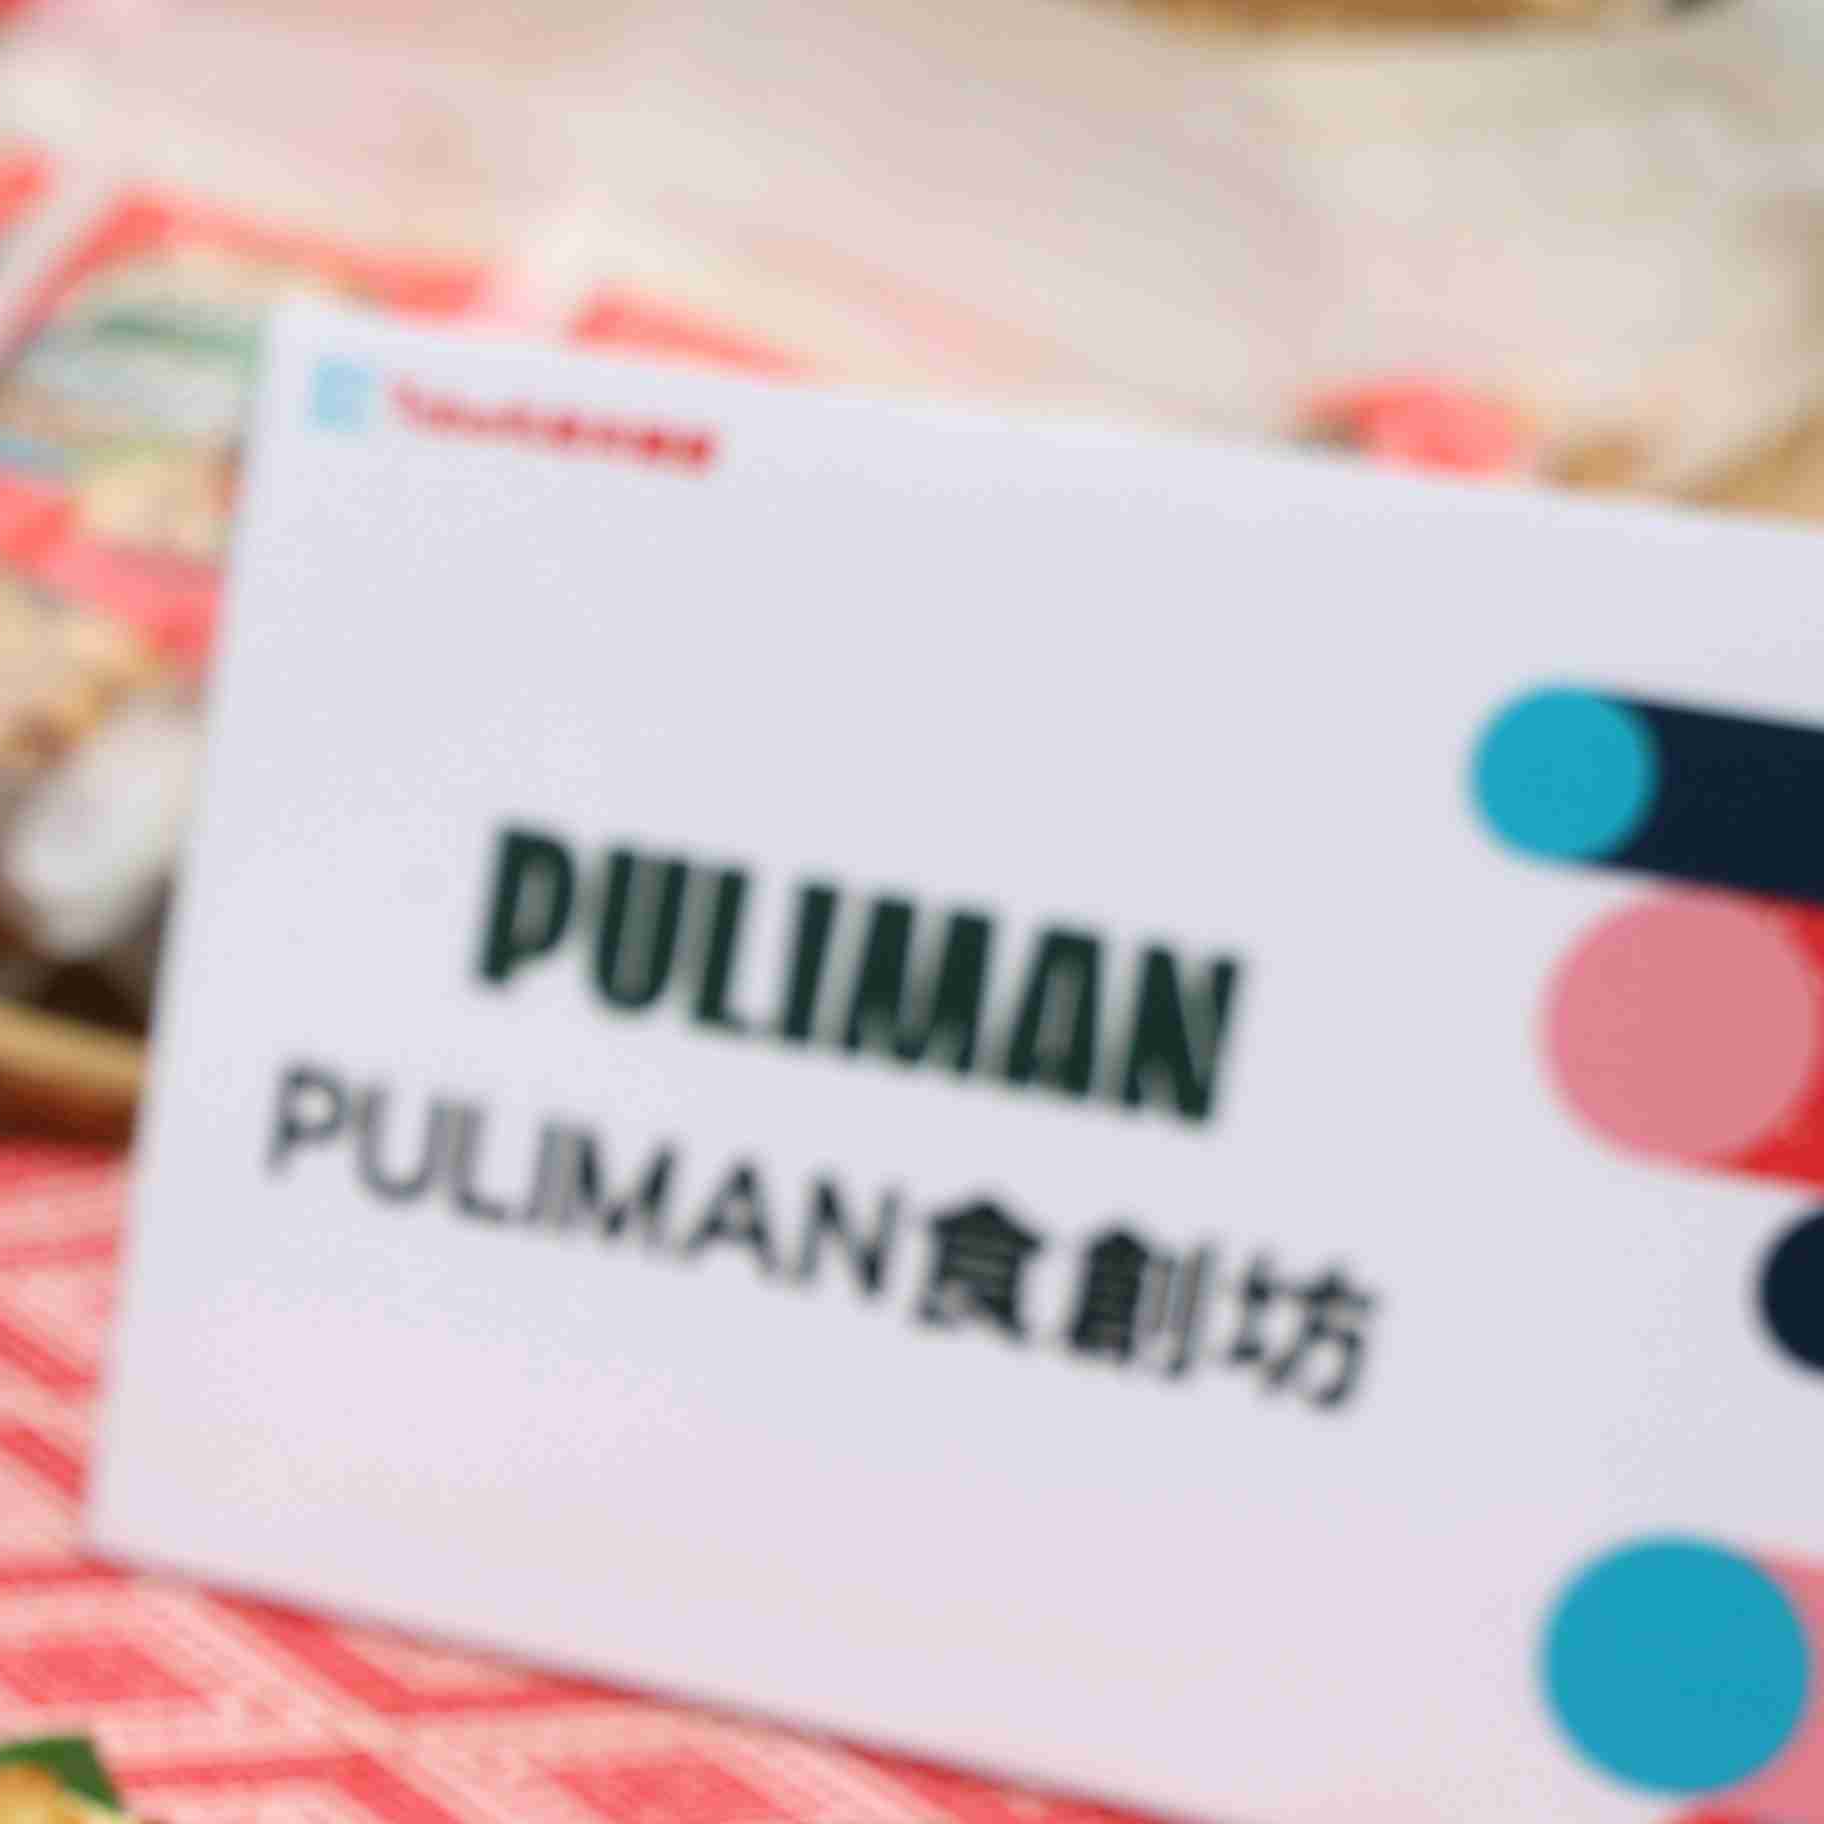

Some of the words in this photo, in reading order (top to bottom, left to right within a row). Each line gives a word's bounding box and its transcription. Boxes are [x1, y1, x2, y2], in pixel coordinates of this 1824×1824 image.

[474, 822, 1246, 1130] PULIMAN
[268, 1062, 1378, 1412] PULIMAN食創坊
